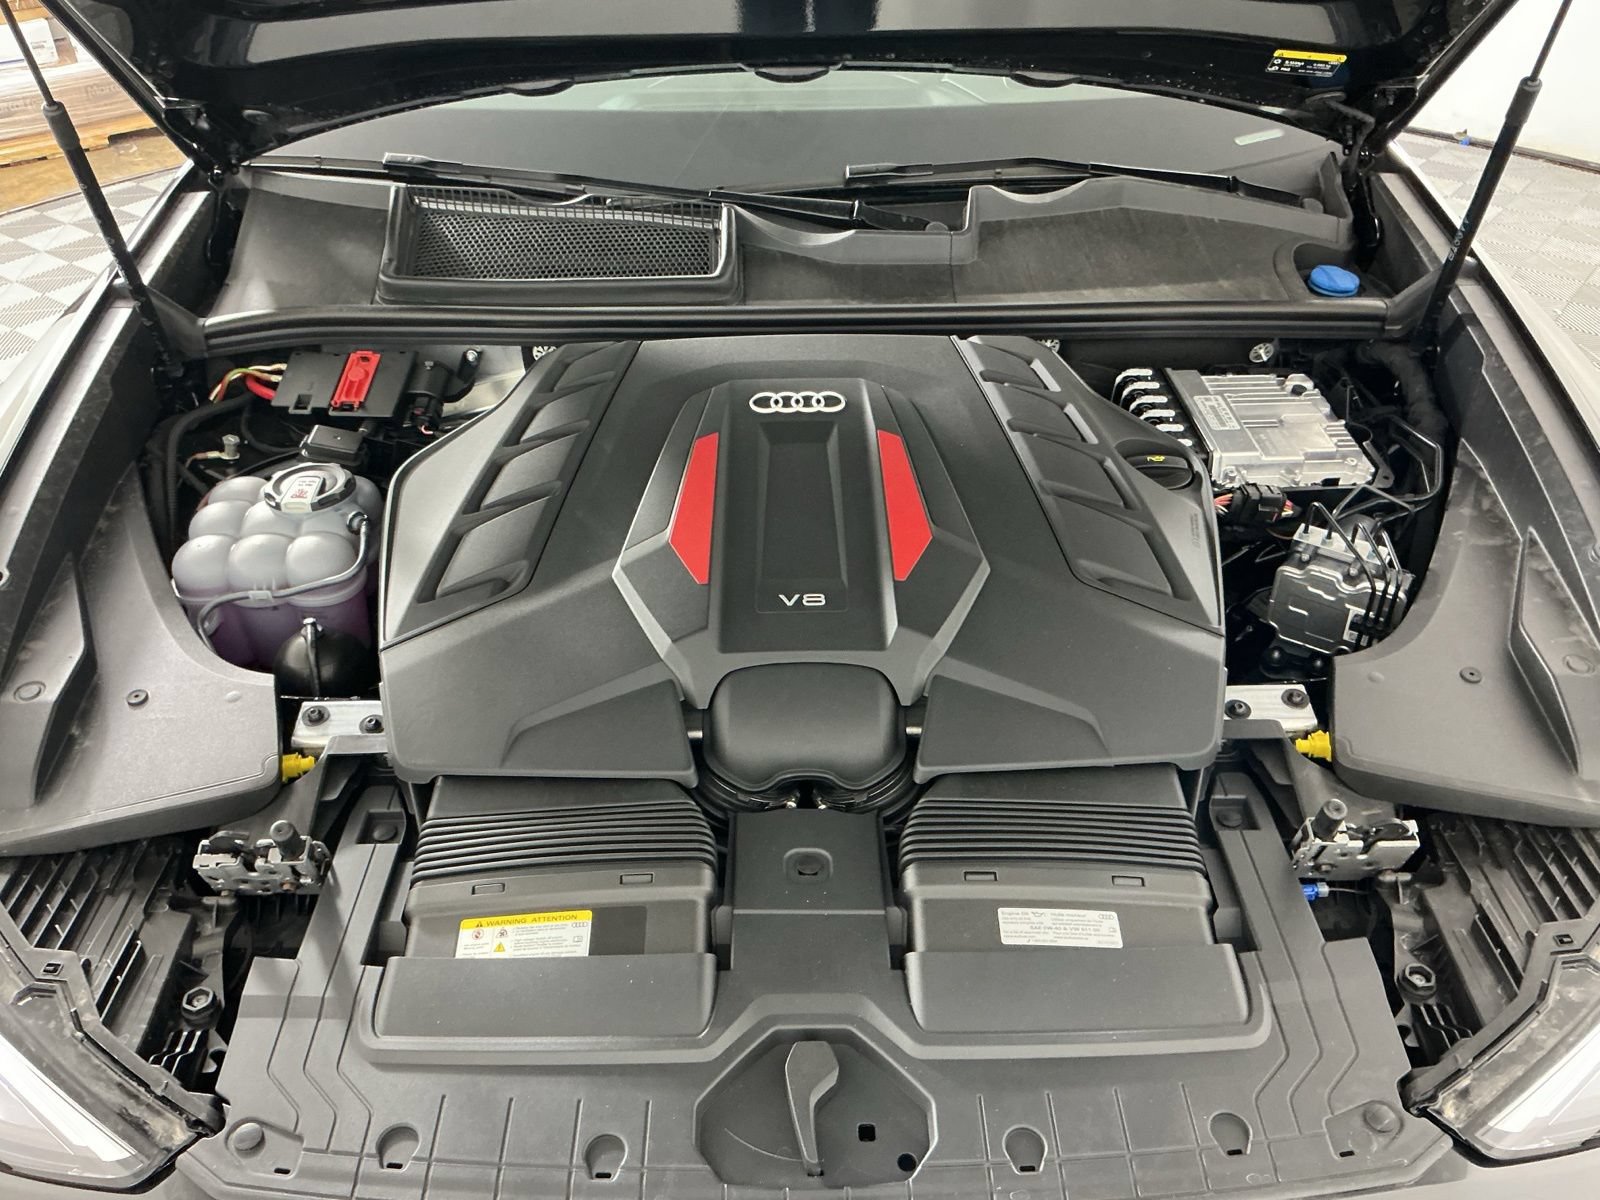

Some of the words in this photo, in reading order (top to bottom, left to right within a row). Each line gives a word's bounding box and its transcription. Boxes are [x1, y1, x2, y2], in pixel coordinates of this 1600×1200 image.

[778, 593, 826, 606] V8
[486, 918, 527, 927] WARNING
[531, 914, 578, 923] ATTENTION
